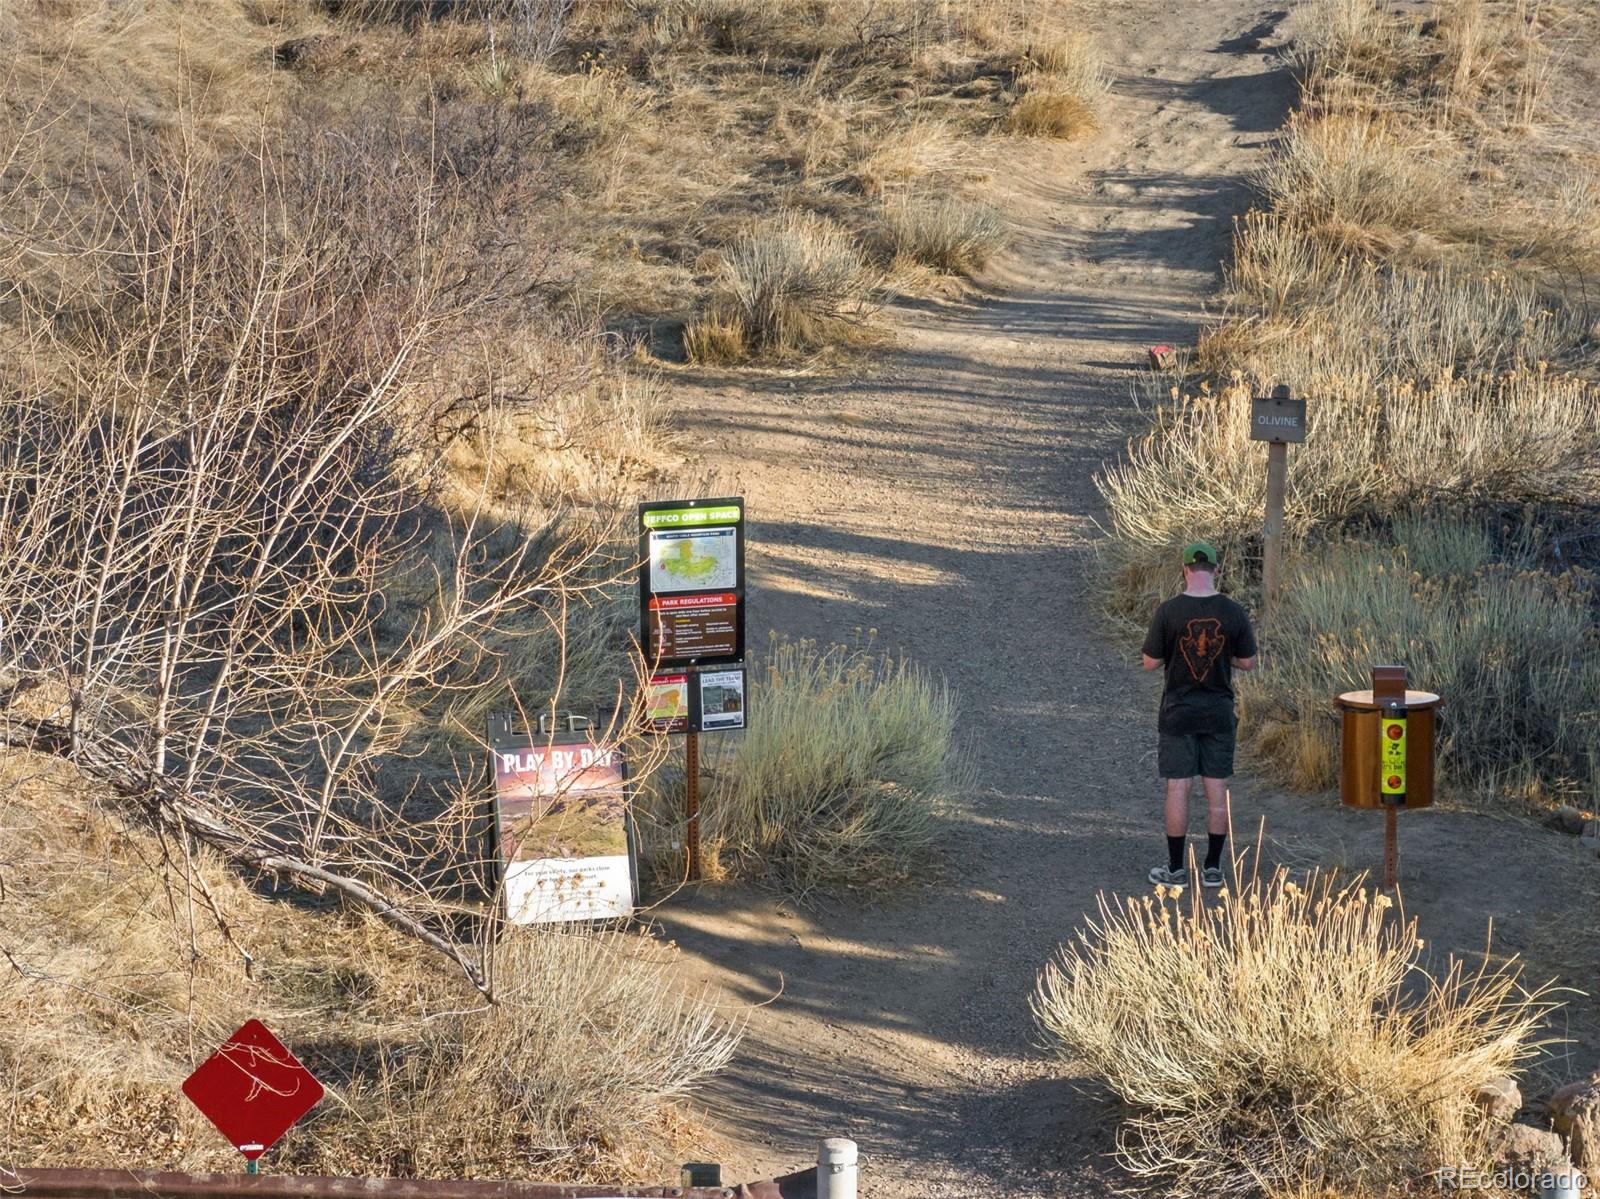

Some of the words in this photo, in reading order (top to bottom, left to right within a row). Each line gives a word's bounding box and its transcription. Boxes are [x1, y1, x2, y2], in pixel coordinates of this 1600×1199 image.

[1258, 415, 1299, 427] OLIVINE
[682, 512, 707, 521] OPEN
[709, 510, 738, 520] SPACE
[662, 599, 679, 607] PARK
[680, 596, 723, 605] REGULATIONS
[503, 753, 545, 773] PLAY
[551, 750, 575, 769] BY
[581, 748, 612, 769] DAY
